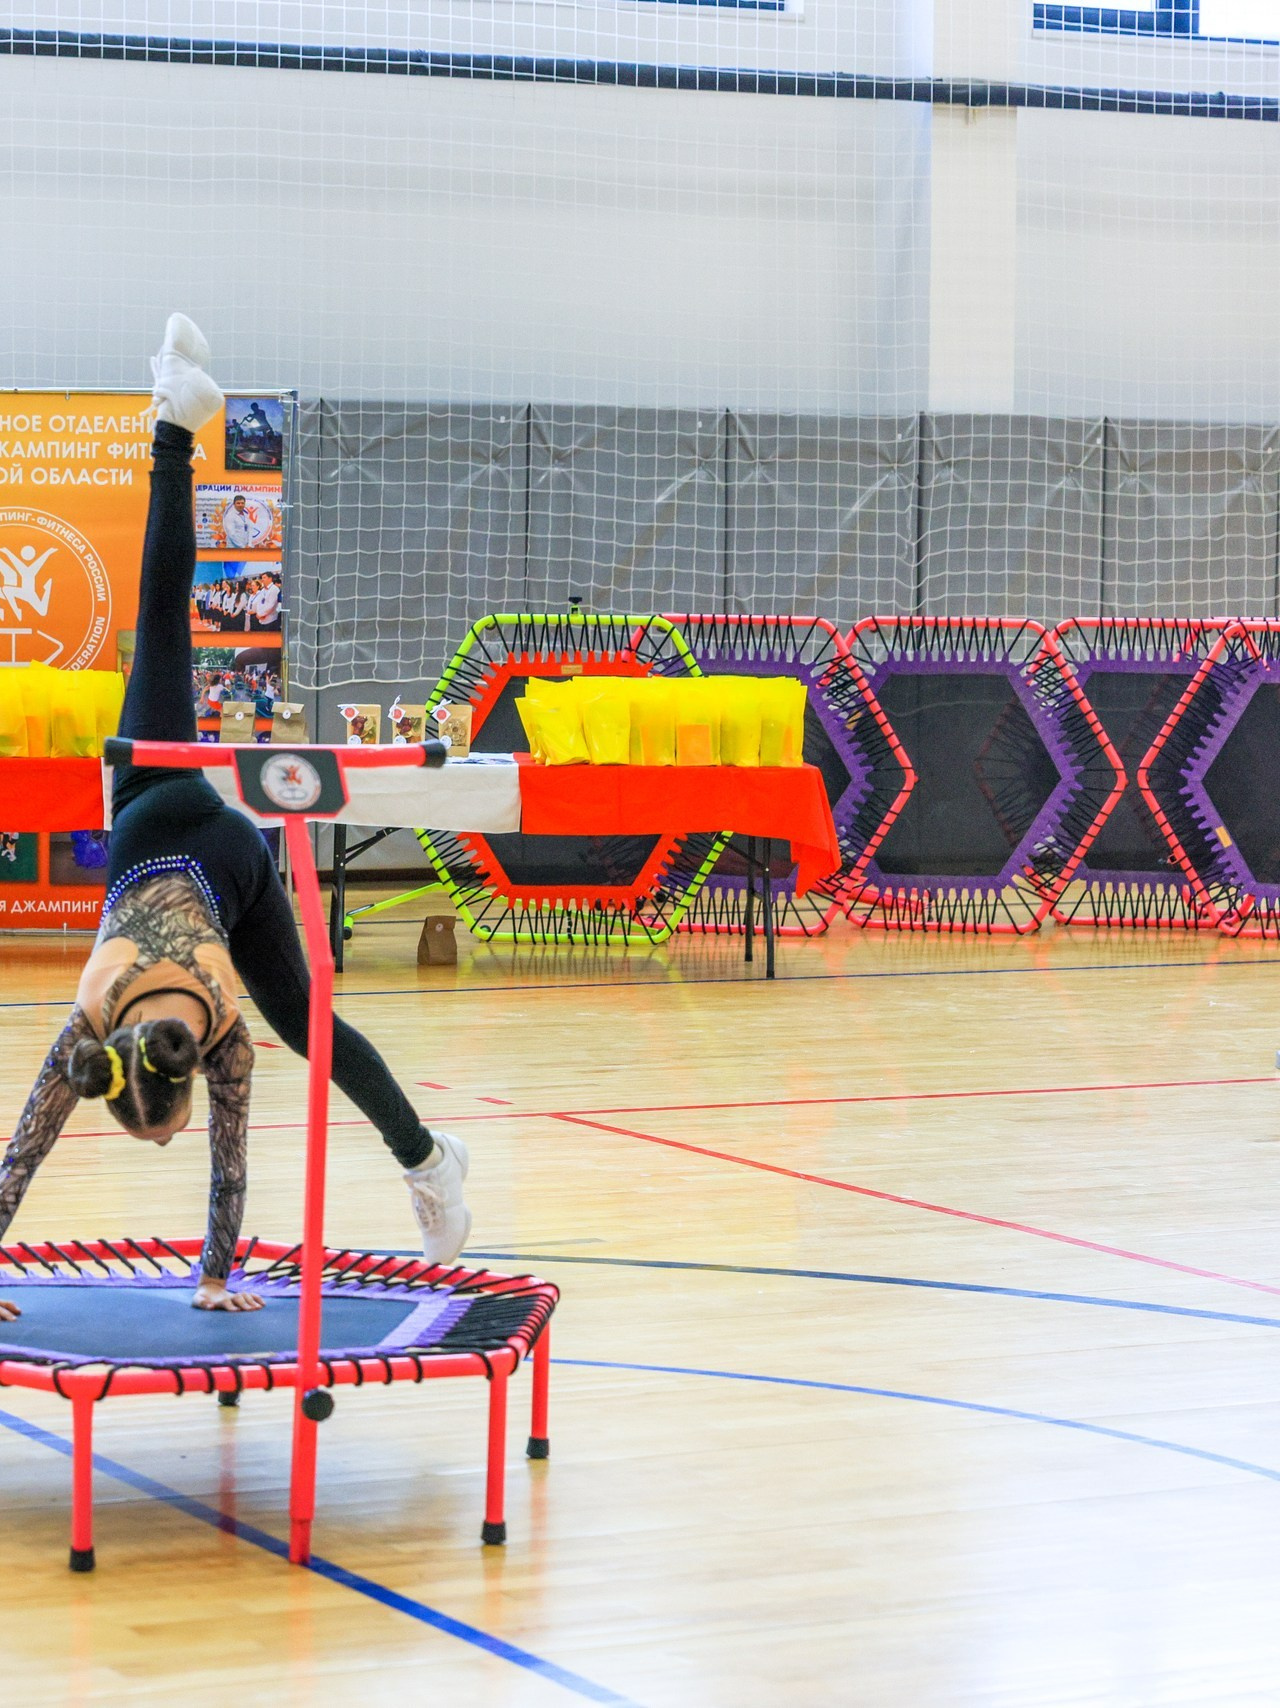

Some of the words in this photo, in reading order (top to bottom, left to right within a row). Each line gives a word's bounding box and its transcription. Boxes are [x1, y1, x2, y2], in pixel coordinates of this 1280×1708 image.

[107, 441, 207, 461] ФИТА
[30, 466, 133, 486] ОБЛАСТИ
[233, 485, 283, 493] ДЖАМПИН
[83, 554, 107, 602] РОССИИ
[11, 899, 99, 914] ДЖАМПИНГ
